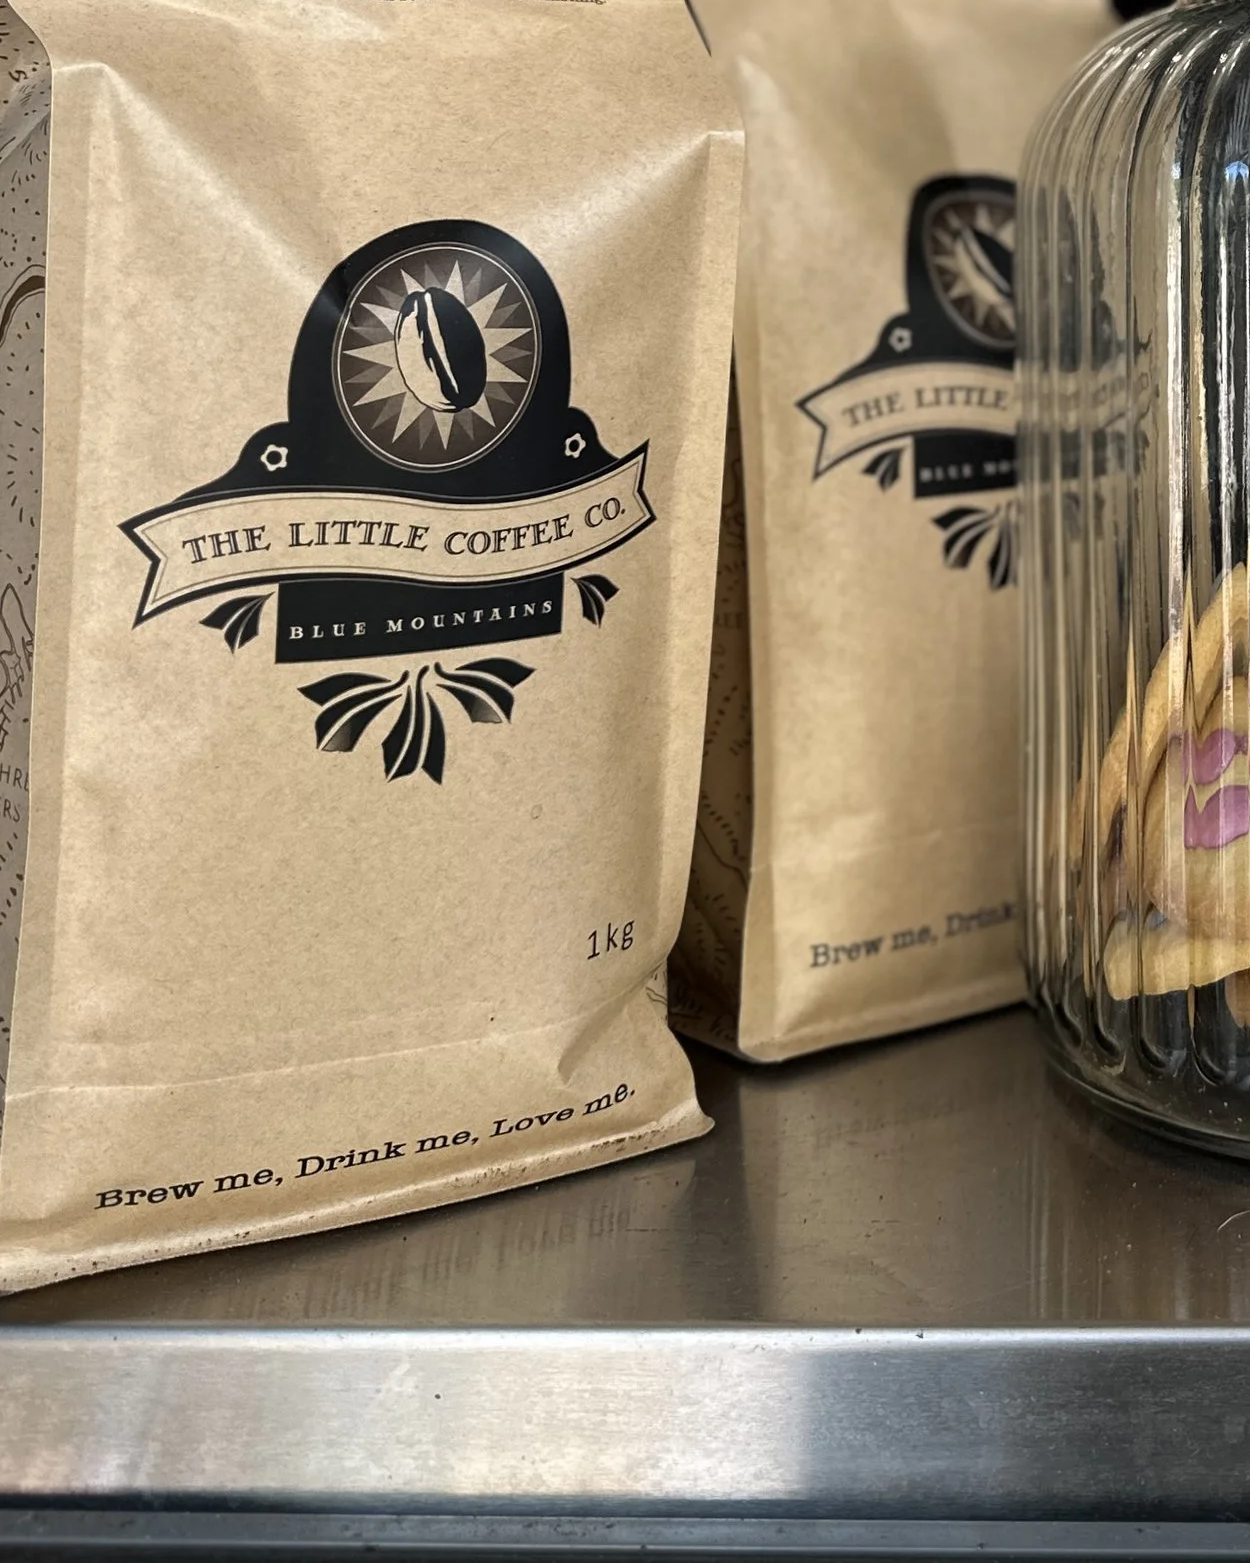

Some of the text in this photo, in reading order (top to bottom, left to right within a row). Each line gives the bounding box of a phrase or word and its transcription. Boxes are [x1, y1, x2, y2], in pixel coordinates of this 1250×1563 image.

[842, 392, 905, 428] THE
[914, 386, 1009, 412] LITTLE
[181, 497, 626, 565] THE LITTLE COFFEE CO.
[288, 599, 554, 640] BLUE MOUNTAINS
[809, 936, 885, 968] Brew
[94, 1083, 637, 1210] Brew me, Drink me, Love me.
